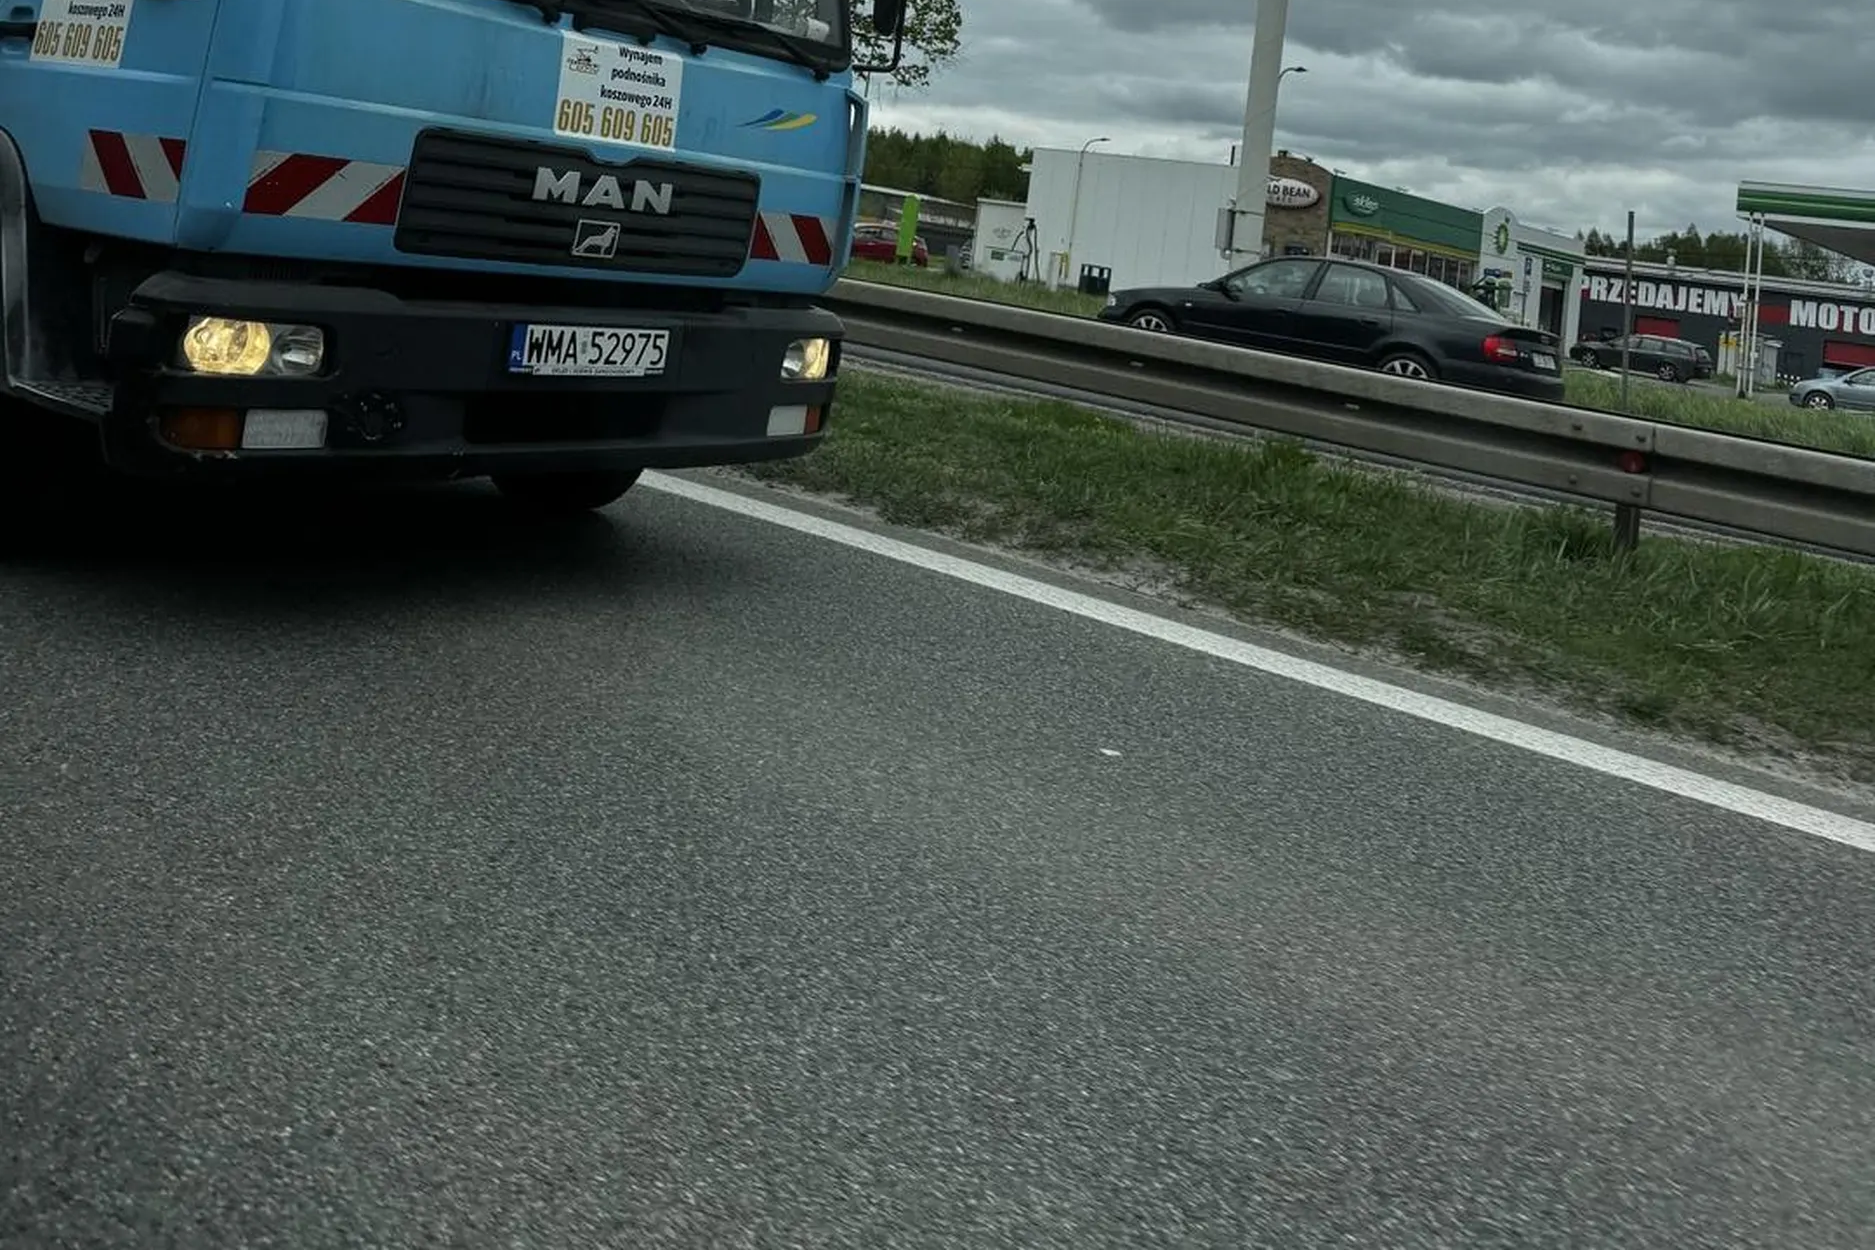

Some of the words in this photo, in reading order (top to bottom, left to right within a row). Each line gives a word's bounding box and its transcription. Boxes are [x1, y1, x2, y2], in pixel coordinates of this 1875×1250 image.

[108, 4, 125, 18] 24H
[34, 19, 63, 56] 605
[62, 22, 92, 58] 609
[92, 25, 124, 61] 605
[618, 45, 663, 66] Wynajem
[611, 67, 666, 87] podnośnika
[600, 85, 651, 108] koszowego
[653, 94, 673, 109] 24H
[558, 98, 595, 135] 605
[600, 106, 636, 141] 609
[640, 112, 674, 147] 605
[532, 166, 673, 215] MAN
[1282, 186, 1311, 199] BEAN
[526, 329, 578, 365] WMA
[588, 331, 666, 366] 52975
